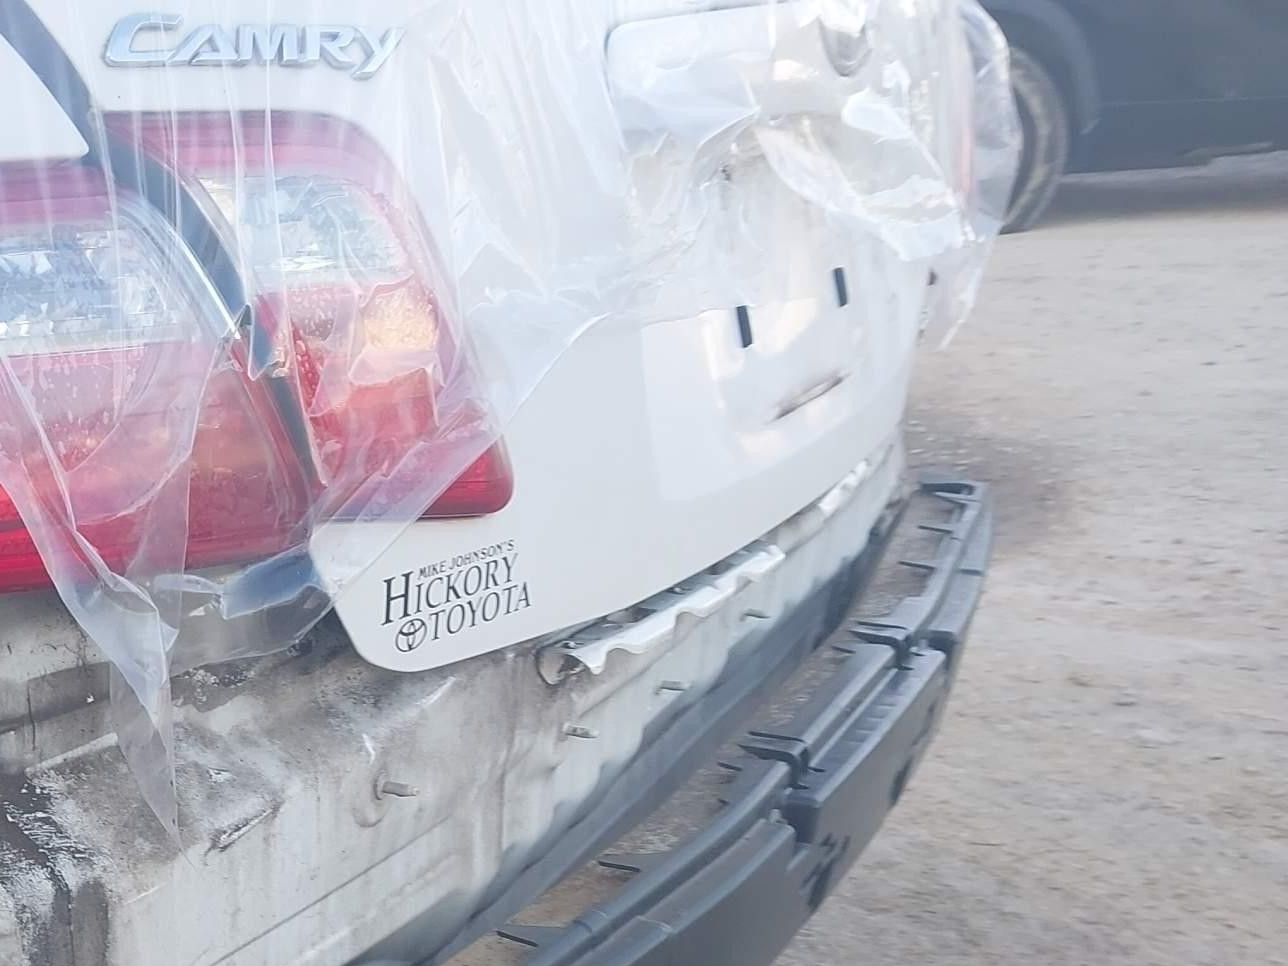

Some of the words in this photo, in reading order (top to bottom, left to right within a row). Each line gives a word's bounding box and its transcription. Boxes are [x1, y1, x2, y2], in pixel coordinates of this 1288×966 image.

[102, 12, 406, 80] CAMRY
[381, 552, 518, 626] HICKORY
[417, 560, 447, 580] MIKE
[448, 539, 515, 570] JOHNSON'S
[429, 582, 531, 640] TOYOTA
